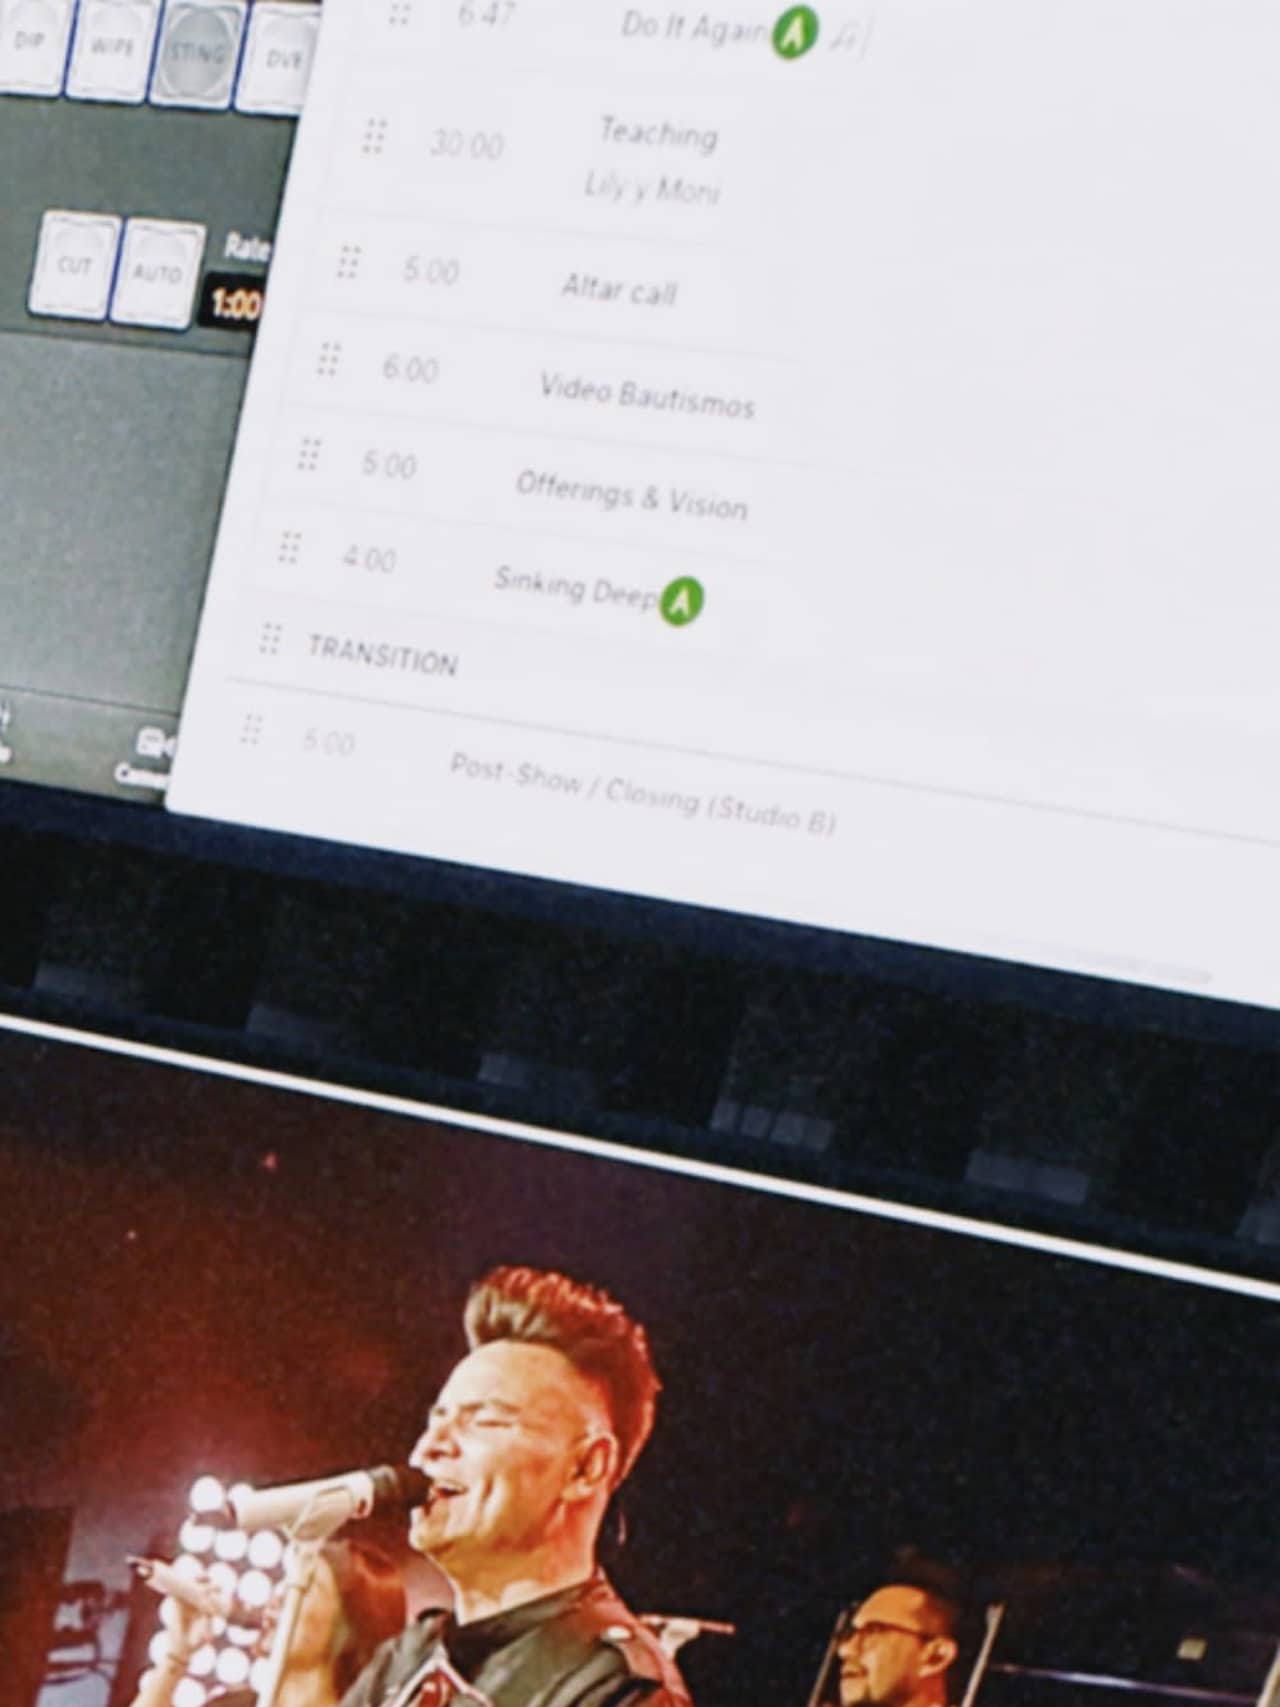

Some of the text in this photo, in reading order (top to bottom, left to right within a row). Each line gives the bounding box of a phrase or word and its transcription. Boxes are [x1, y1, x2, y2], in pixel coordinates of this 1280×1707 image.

[621, 9, 659, 38] Do
[600, 115, 719, 156] Teaching
[57, 256, 93, 276] CUT
[133, 264, 183, 286] AUTO
[561, 271, 679, 307] Altar call
[540, 369, 757, 420] Video Bautismos
[515, 467, 749, 521] Offerings & Vision
[493, 564, 585, 605] Sinking
[308, 633, 460, 678] TRANSITION
[449, 752, 583, 798] Post-Show
[606, 778, 700, 819] Closing
